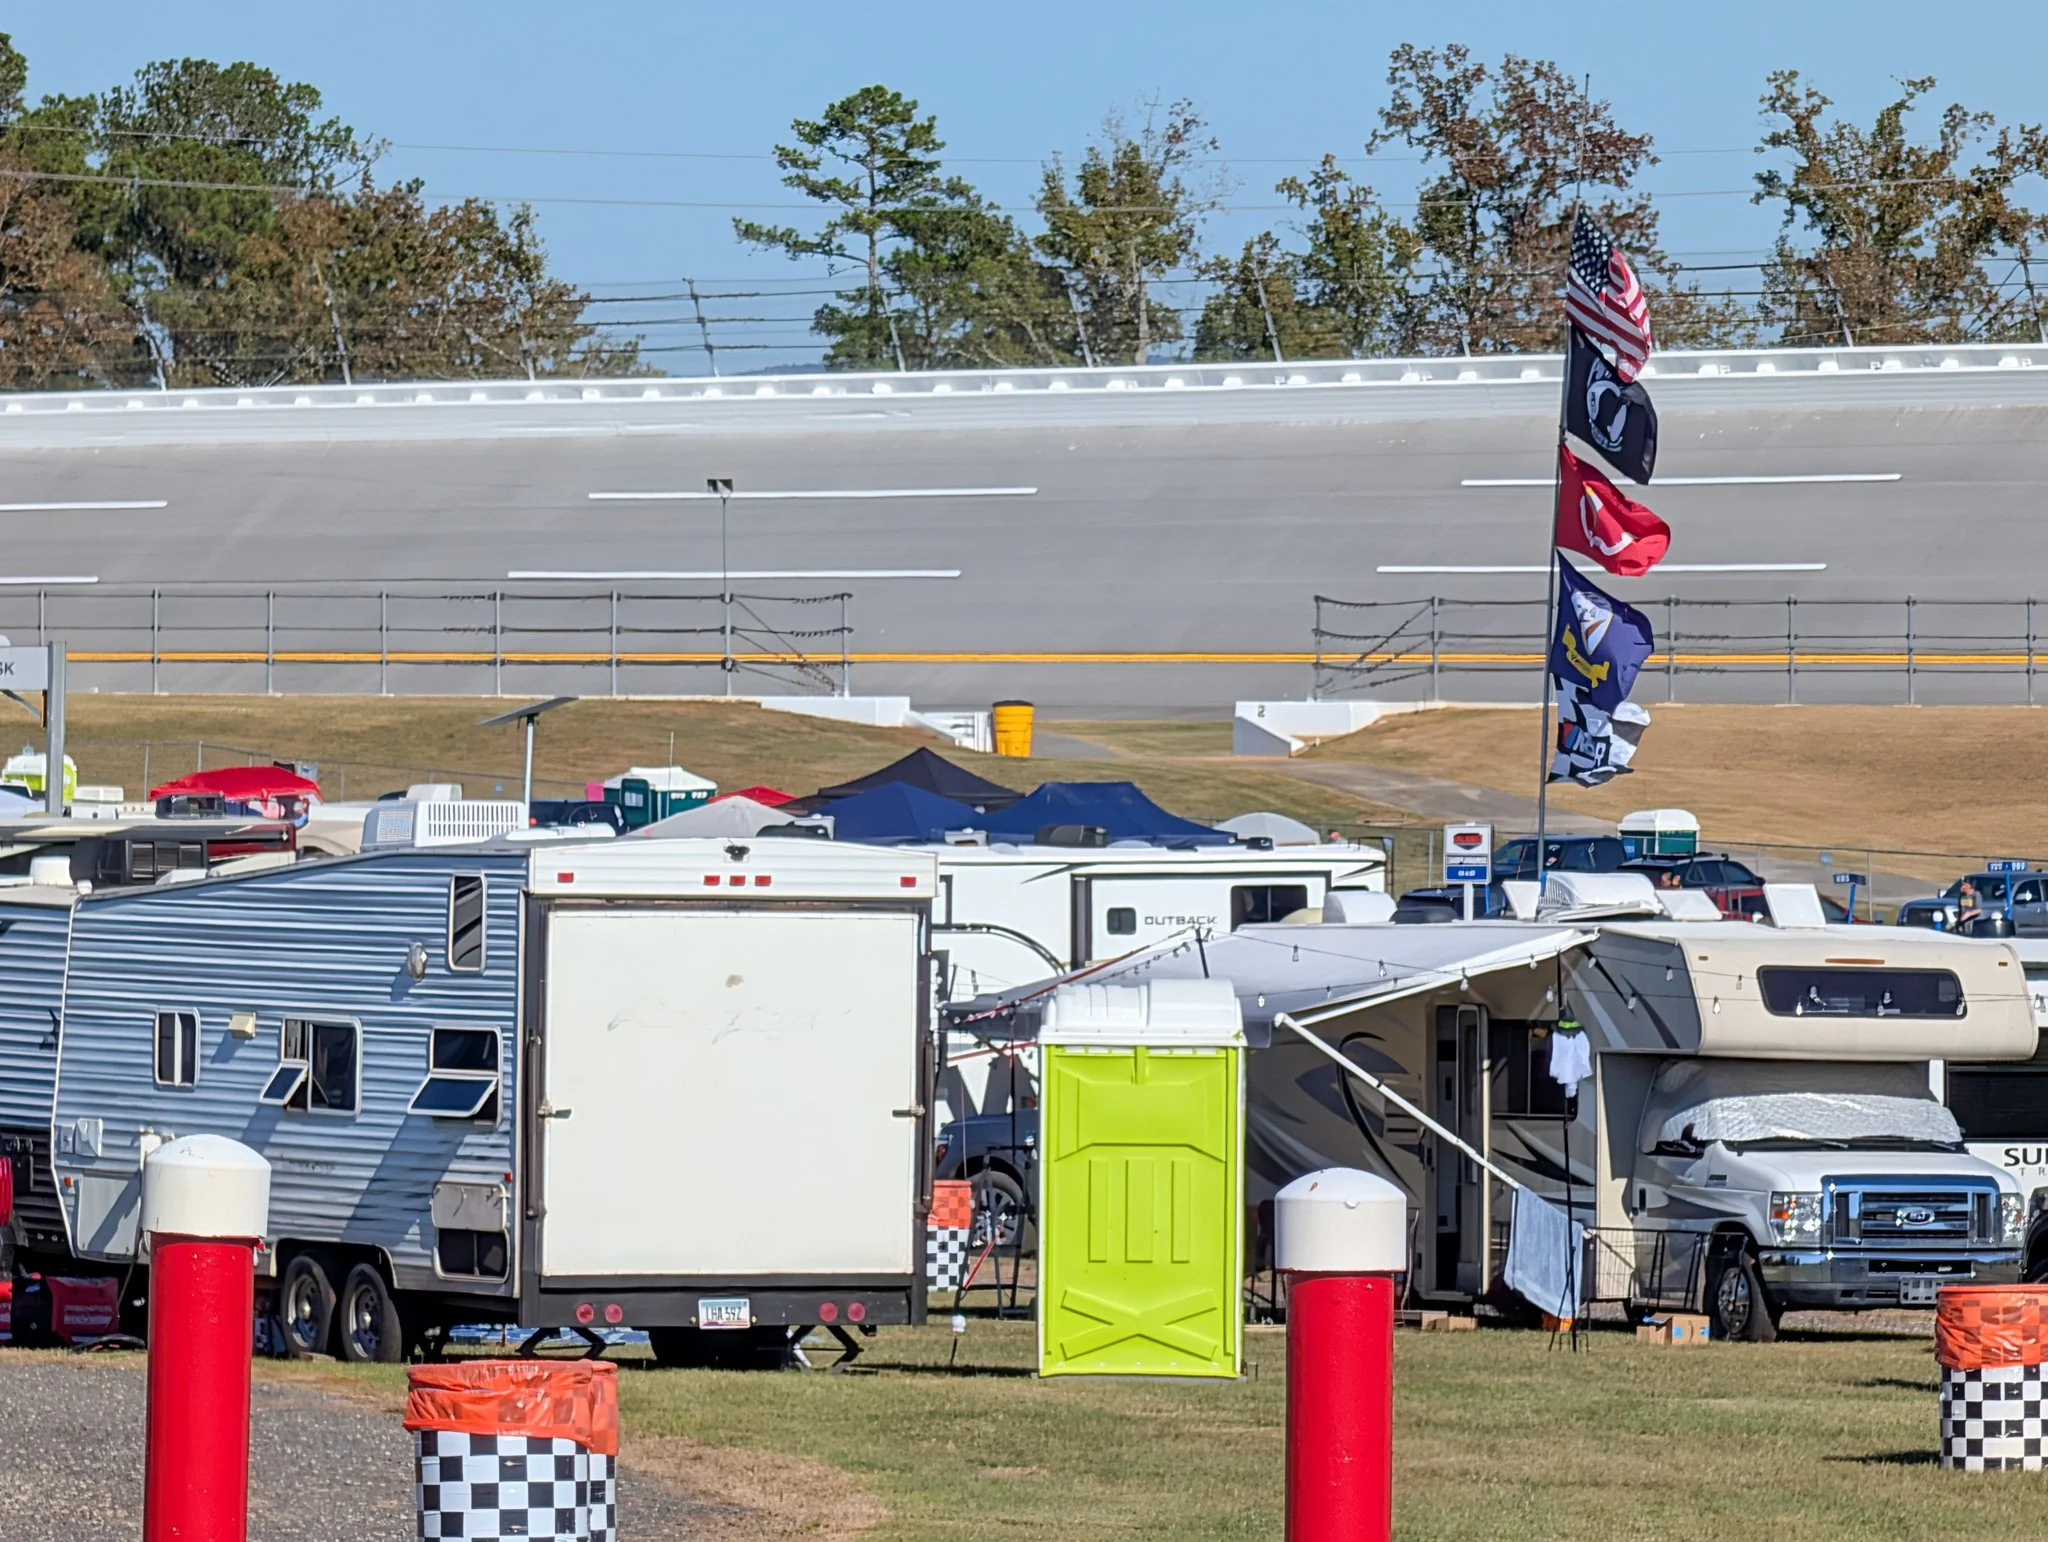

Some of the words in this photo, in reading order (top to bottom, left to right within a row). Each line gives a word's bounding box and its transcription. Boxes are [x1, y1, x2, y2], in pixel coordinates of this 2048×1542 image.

[1257, 704, 1266, 718] 2
[1144, 915, 1218, 926] OUTBACK
[2004, 1147, 2048, 1167] SU
